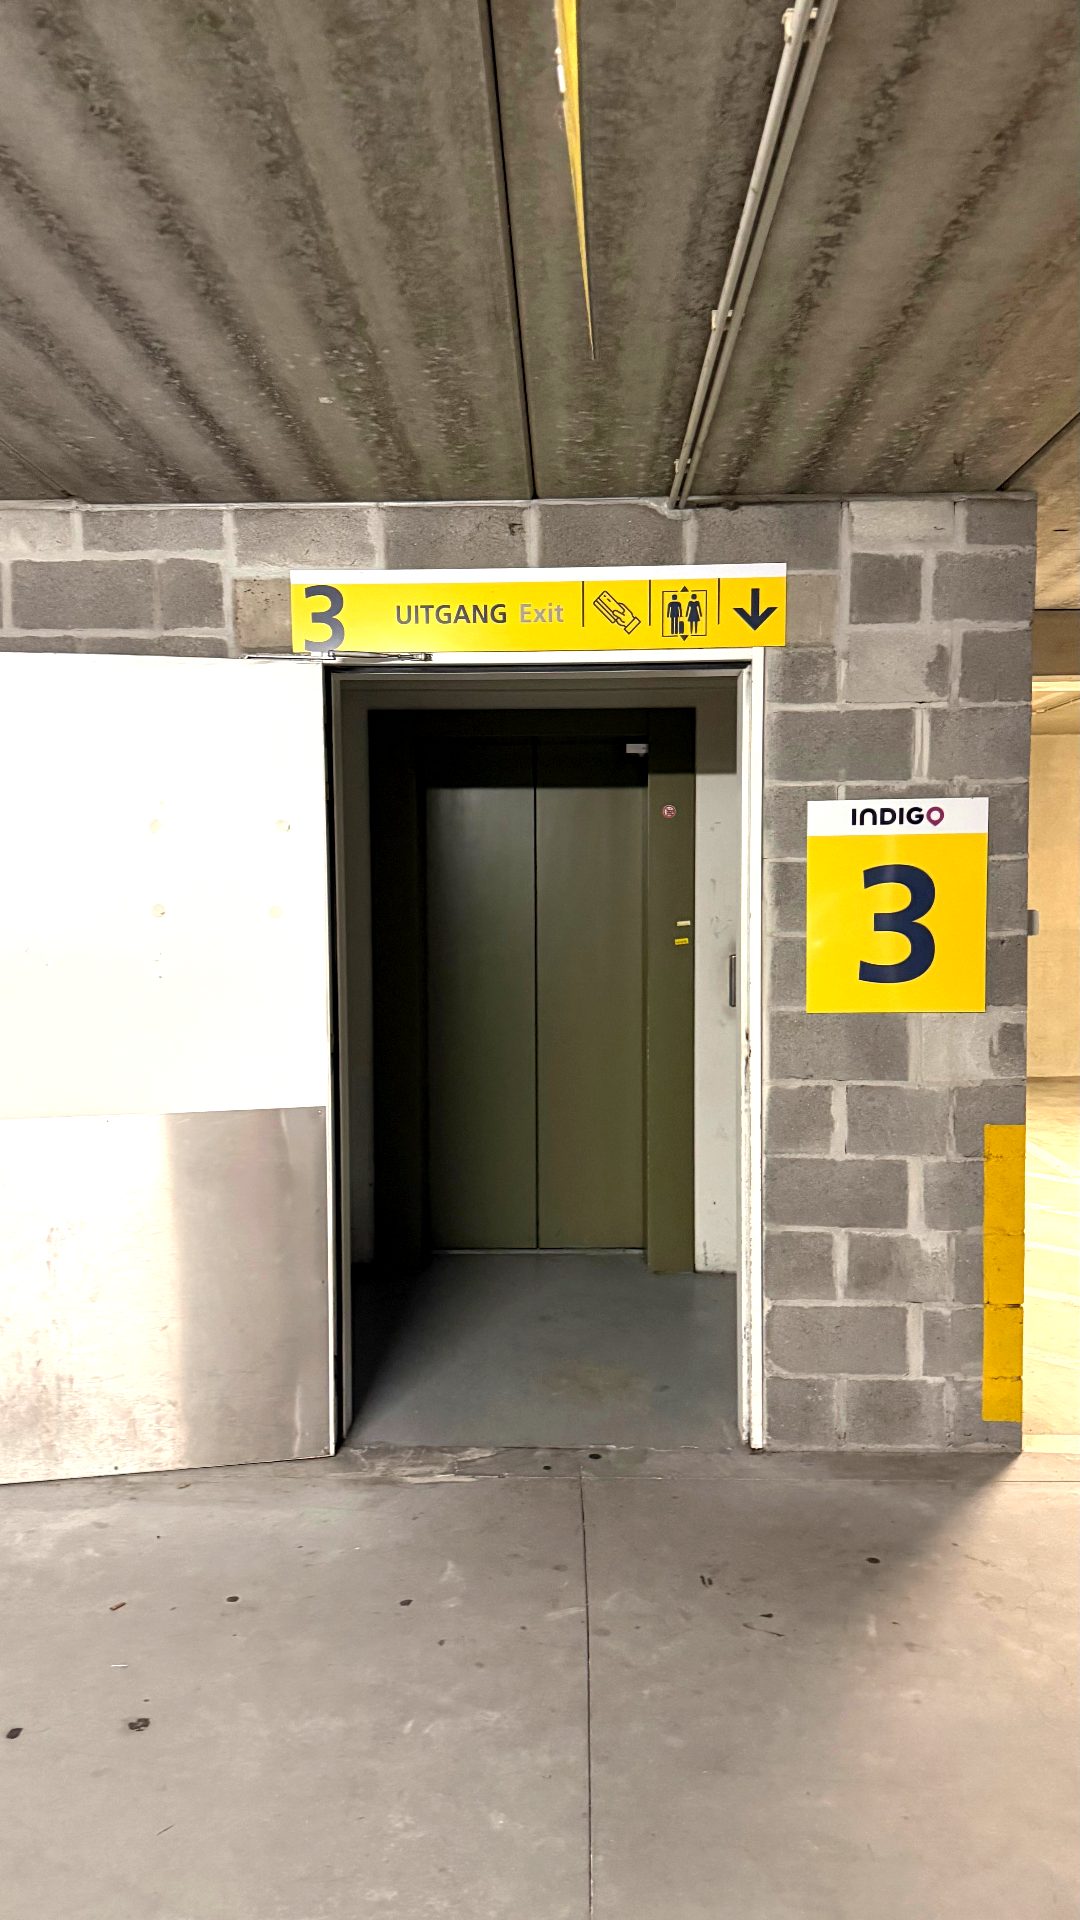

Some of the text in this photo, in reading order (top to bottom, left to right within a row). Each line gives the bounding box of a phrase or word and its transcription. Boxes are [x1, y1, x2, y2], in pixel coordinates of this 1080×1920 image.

[303, 584, 564, 652] 3 UITGANG Exit
[851, 806, 945, 827] INDIGO
[858, 863, 936, 984] 3
